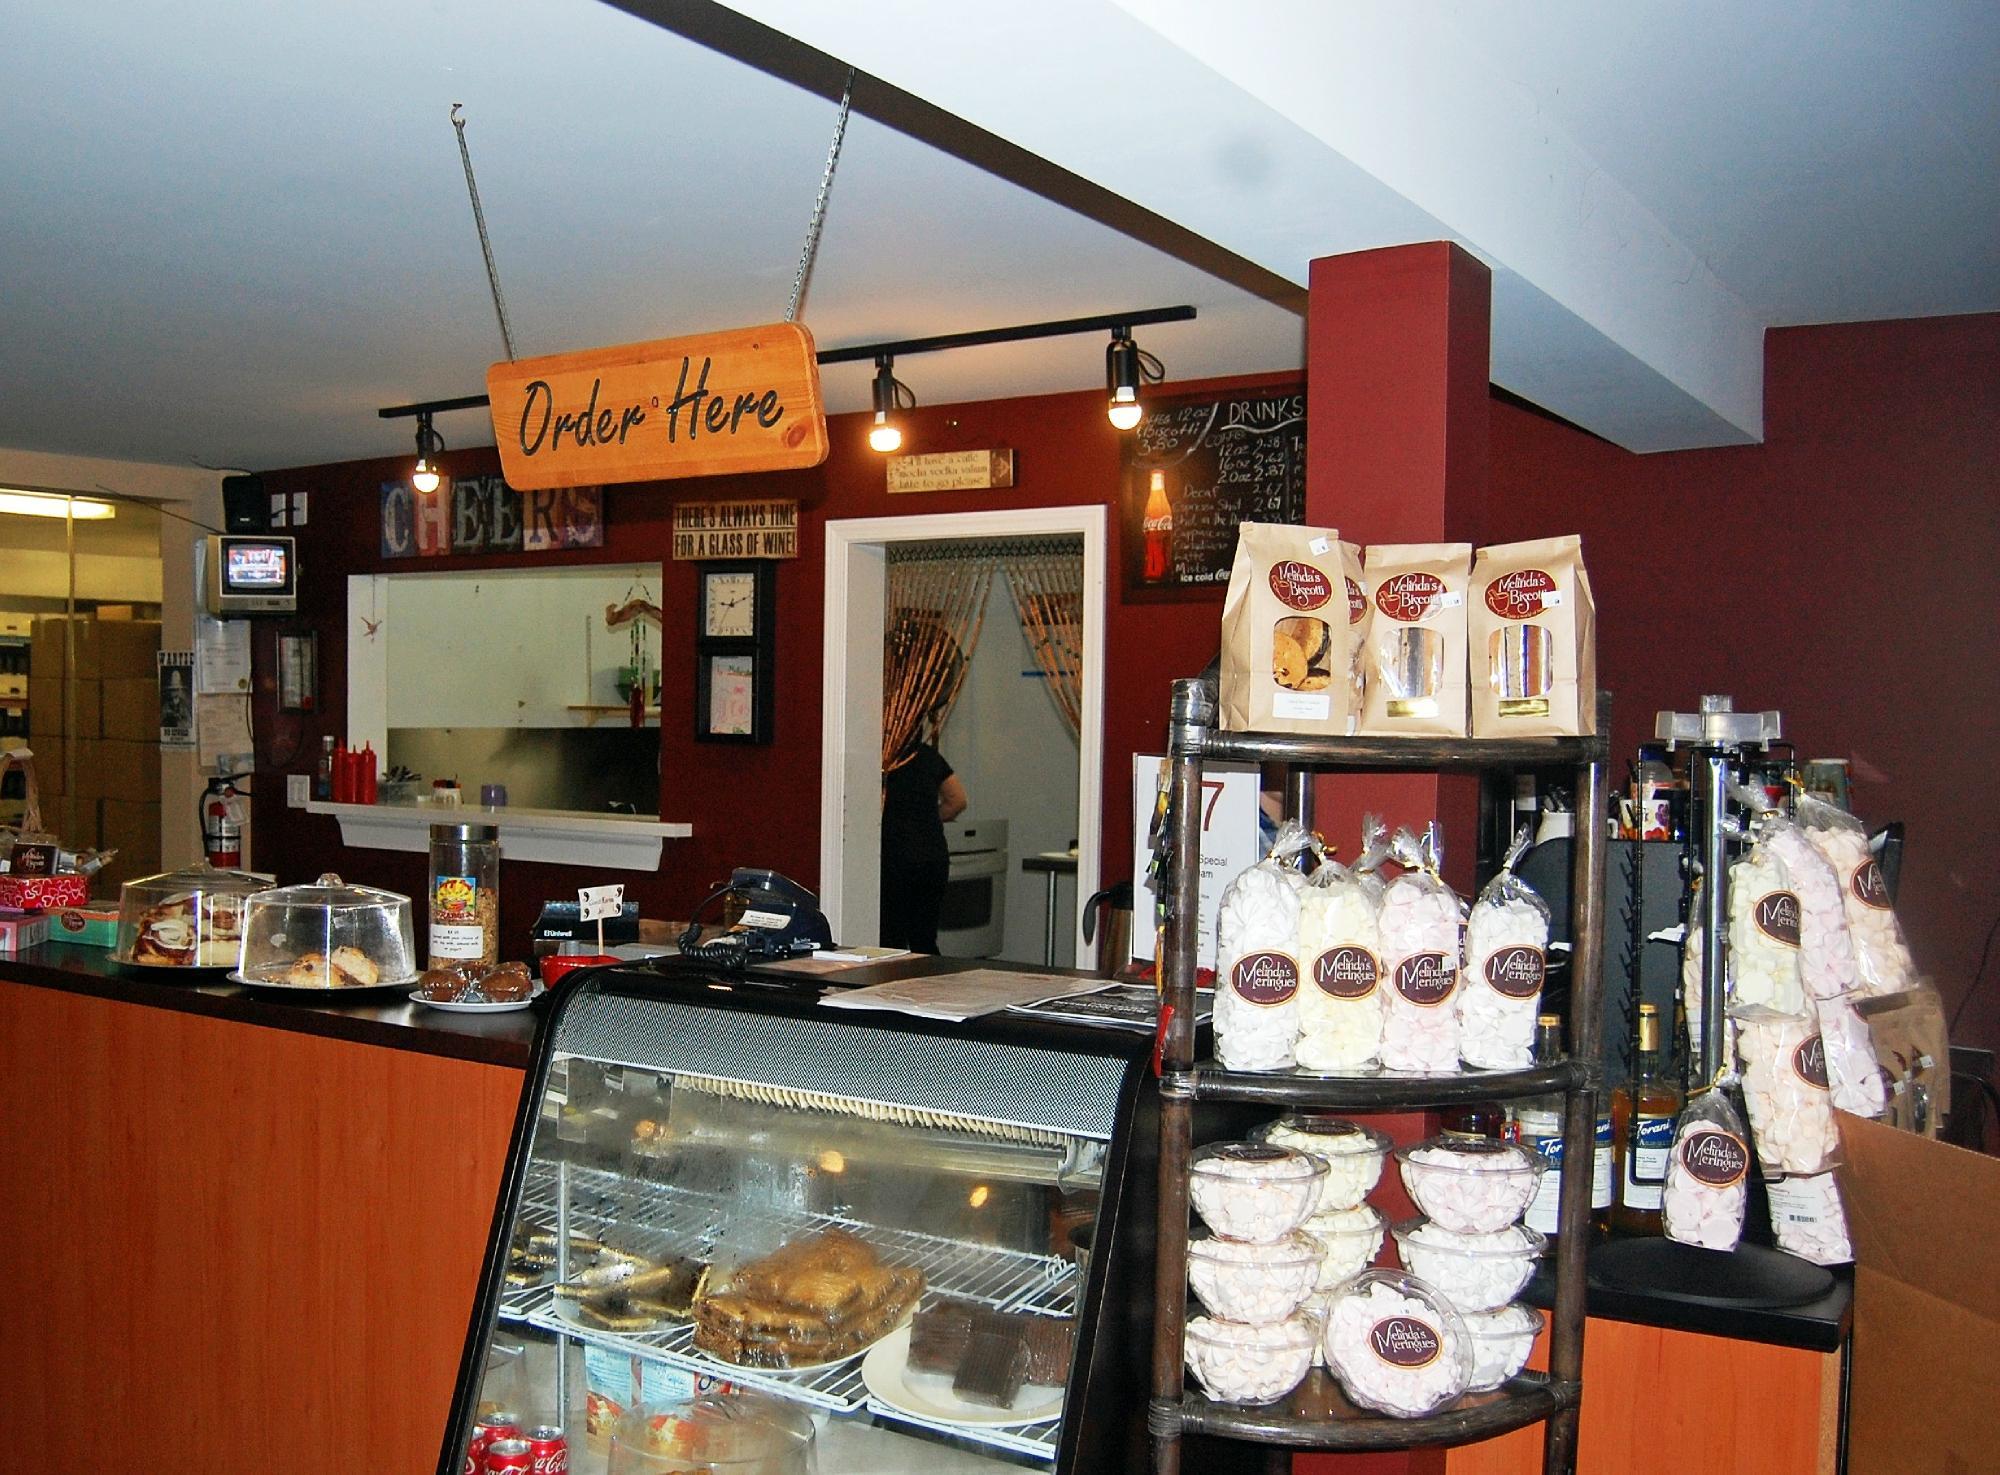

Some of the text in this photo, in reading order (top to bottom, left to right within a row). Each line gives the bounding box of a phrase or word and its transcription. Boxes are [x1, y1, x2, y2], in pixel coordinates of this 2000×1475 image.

[519, 356, 784, 456] Order Here
[1229, 395, 1304, 424] DRINKS
[384, 476, 597, 553] CHEERS
[676, 503, 796, 528] THERE'S ALWAYS TIME
[675, 531, 796, 557] FOR A GLASS OF WINE!
[1195, 573, 1213, 582] cold
[1279, 561, 1321, 583] Melinda's
[1389, 573, 1438, 594] Melinda's
[1499, 569, 1546, 592] Melinda's
[1291, 580, 1325, 607] Biscotti
[1238, 956, 1291, 989] Melinda's
[1320, 950, 1372, 983] Melinda's
[1596, 1119, 1611, 1134] ani
[1637, 1118, 1671, 1139] Torani
[1538, 1138, 1563, 1156] Tor
[1687, 1135, 1739, 1166] Melinda's
[1374, 1320, 1427, 1354] Melinda's
